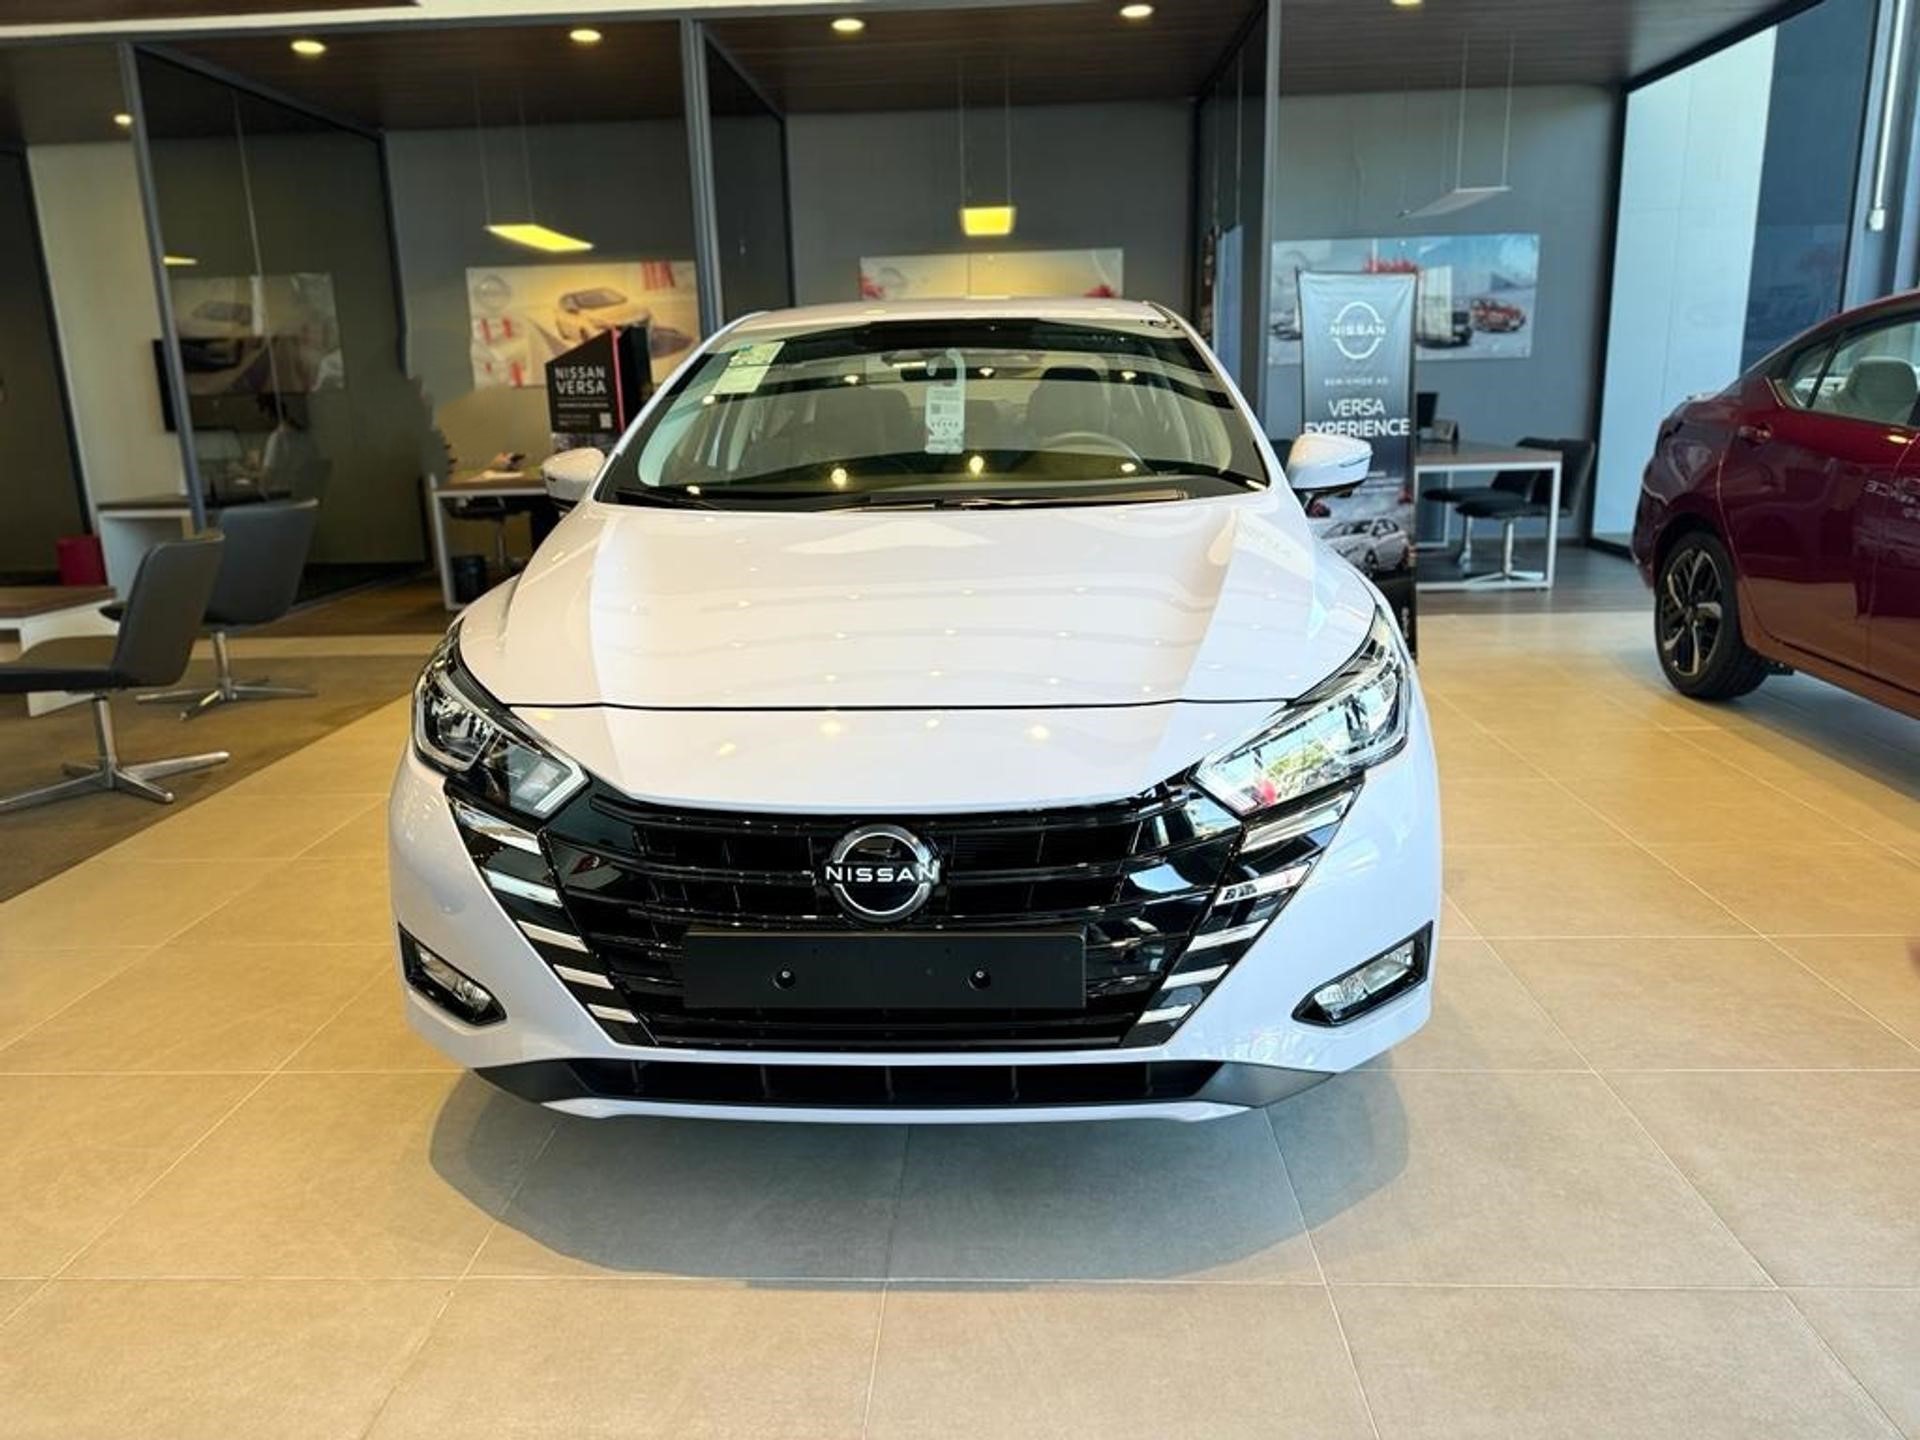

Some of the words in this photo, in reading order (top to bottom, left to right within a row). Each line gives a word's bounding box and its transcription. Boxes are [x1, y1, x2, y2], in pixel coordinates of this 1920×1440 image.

[1330, 324, 1387, 336] NISSAN
[554, 366, 606, 380] NISSAN
[556, 379, 608, 395] VERSA
[1328, 398, 1386, 418] VERSA
[825, 861, 939, 882] NISSAN
